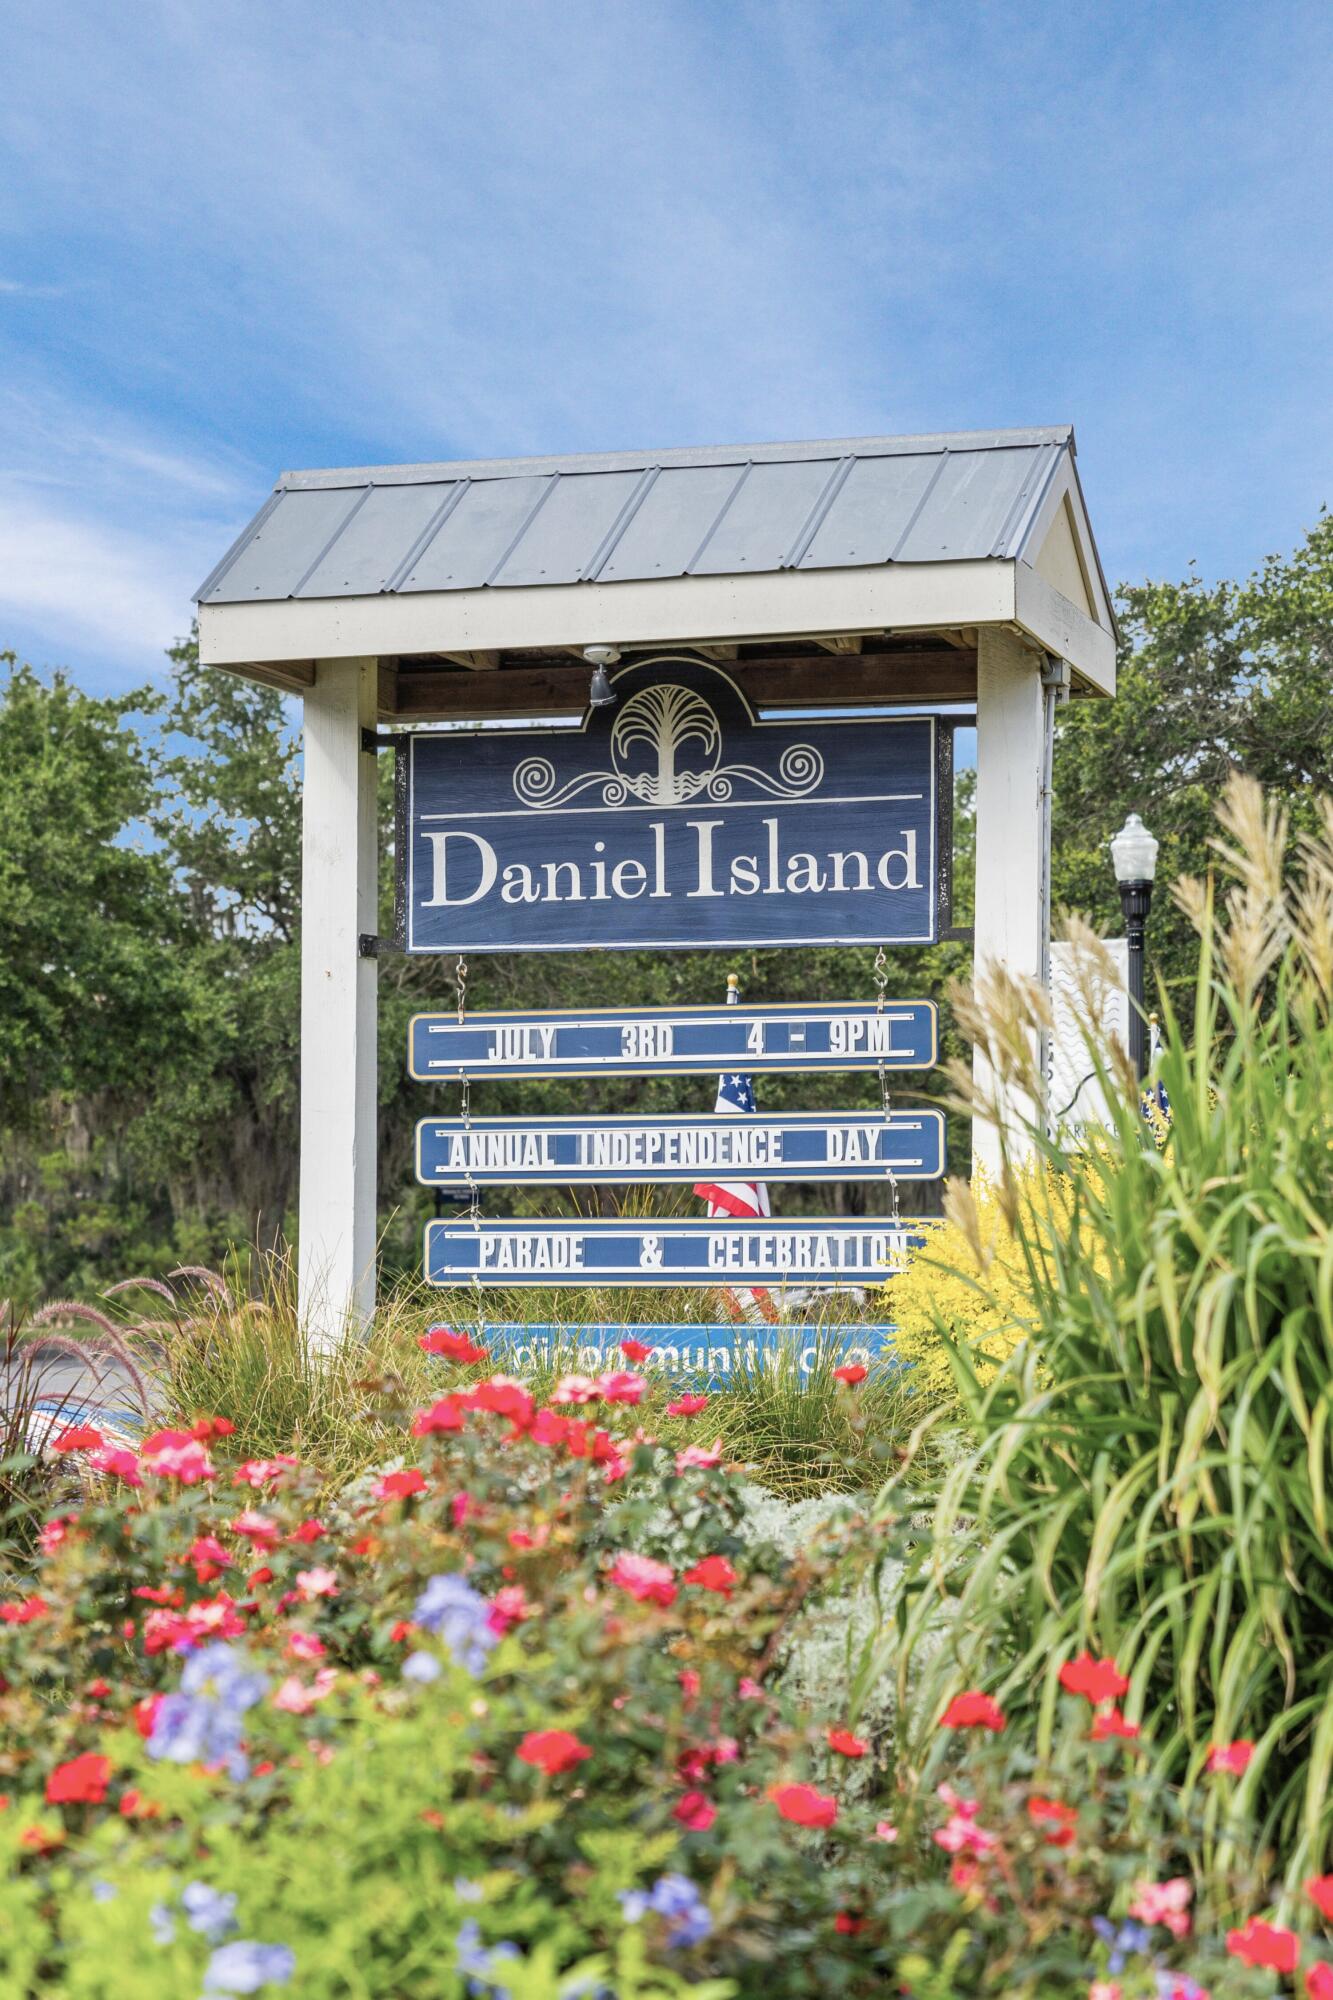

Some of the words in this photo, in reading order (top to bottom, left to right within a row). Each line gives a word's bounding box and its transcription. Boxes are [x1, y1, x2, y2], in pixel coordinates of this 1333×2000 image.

[420, 822, 672, 908] Daniel
[685, 818, 923, 899] Island
[487, 1026, 555, 1062] JULY
[621, 1024, 674, 1060] 3RD
[747, 1020, 765, 1057] 4
[829, 1017, 891, 1055] 9PM
[449, 1133, 555, 1168] ANNUAL
[580, 1127, 783, 1166] INDEPENDENCE
[826, 1127, 881, 1163] DAY
[479, 1235, 584, 1269] PARADE
[639, 1235, 664, 1268] &
[707, 1233, 909, 1269] CELEBRATION
